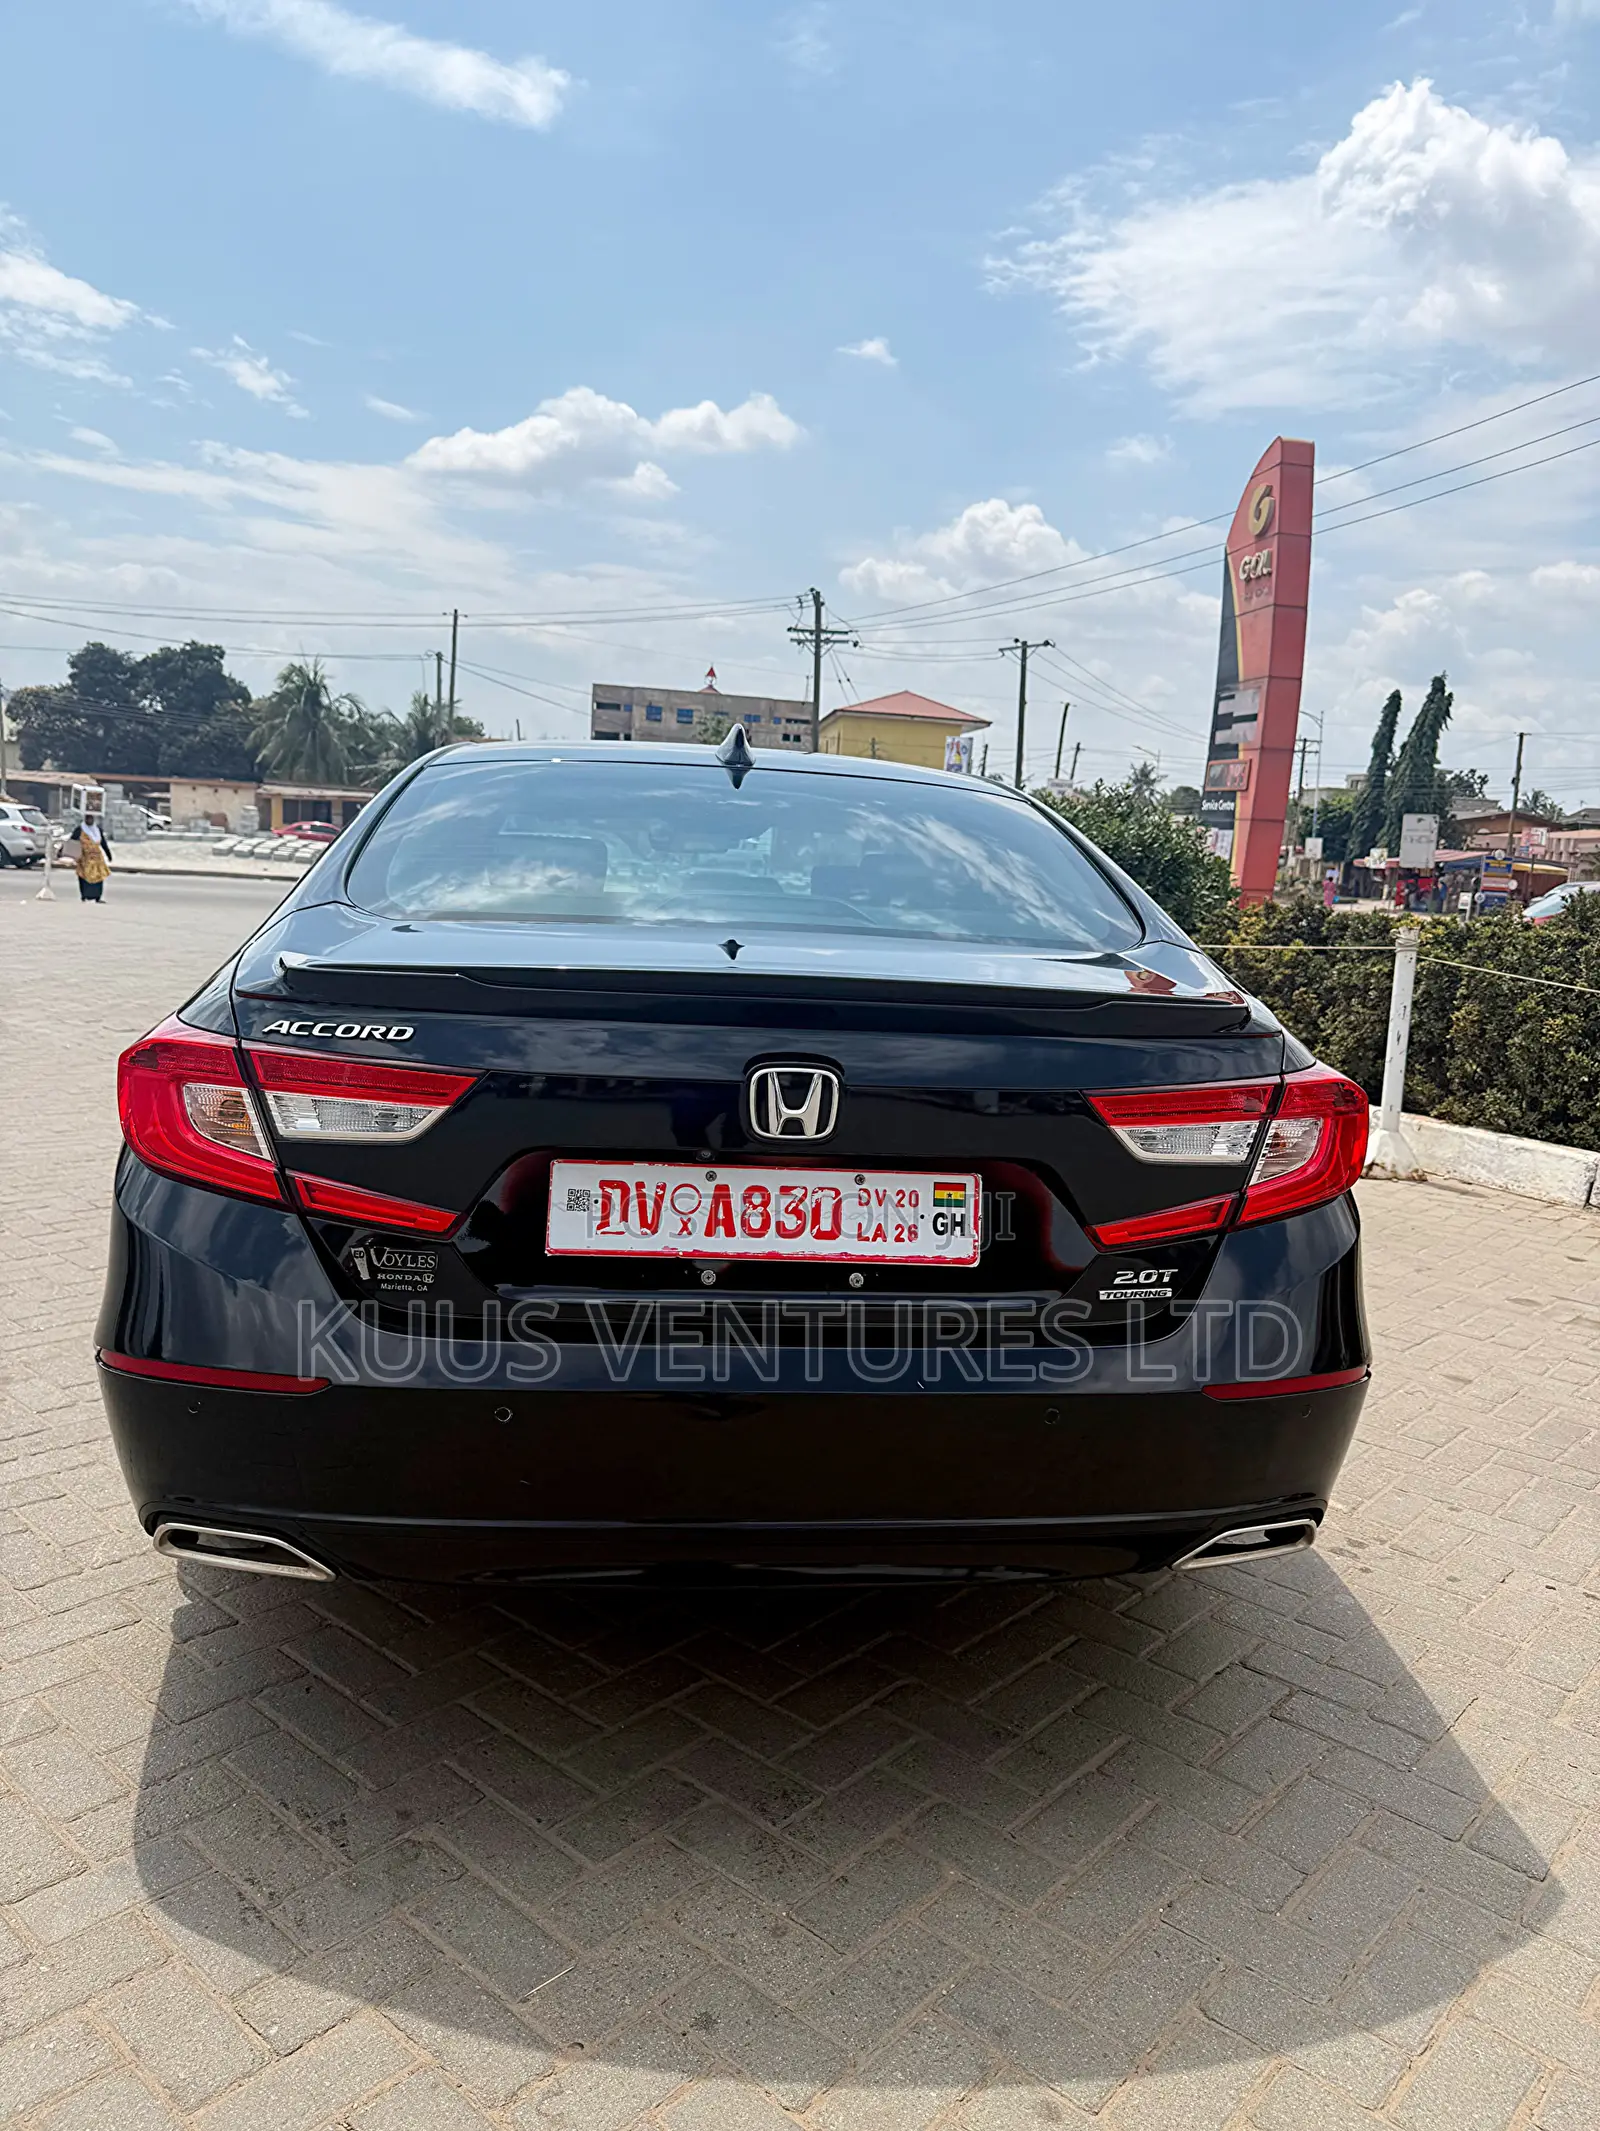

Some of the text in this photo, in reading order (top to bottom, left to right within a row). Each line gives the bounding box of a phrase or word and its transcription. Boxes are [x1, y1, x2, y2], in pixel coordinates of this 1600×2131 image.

[1201, 799, 1218, 811] Service
[262, 1020, 414, 1040] ACCORD
[858, 1188, 919, 1208] DV 20
[597, 1180, 667, 1235] DV
[704, 1184, 842, 1241] A830
[857, 1222, 919, 1243] LA 26
[932, 1212, 966, 1238] GH
[370, 1246, 436, 1268] VOYLES
[377, 1273, 421, 1281] HONDA
[1113, 1269, 1179, 1284] 2.0T
[381, 1283, 415, 1292] Marietta,
[1105, 1289, 1168, 1299] TOURING
